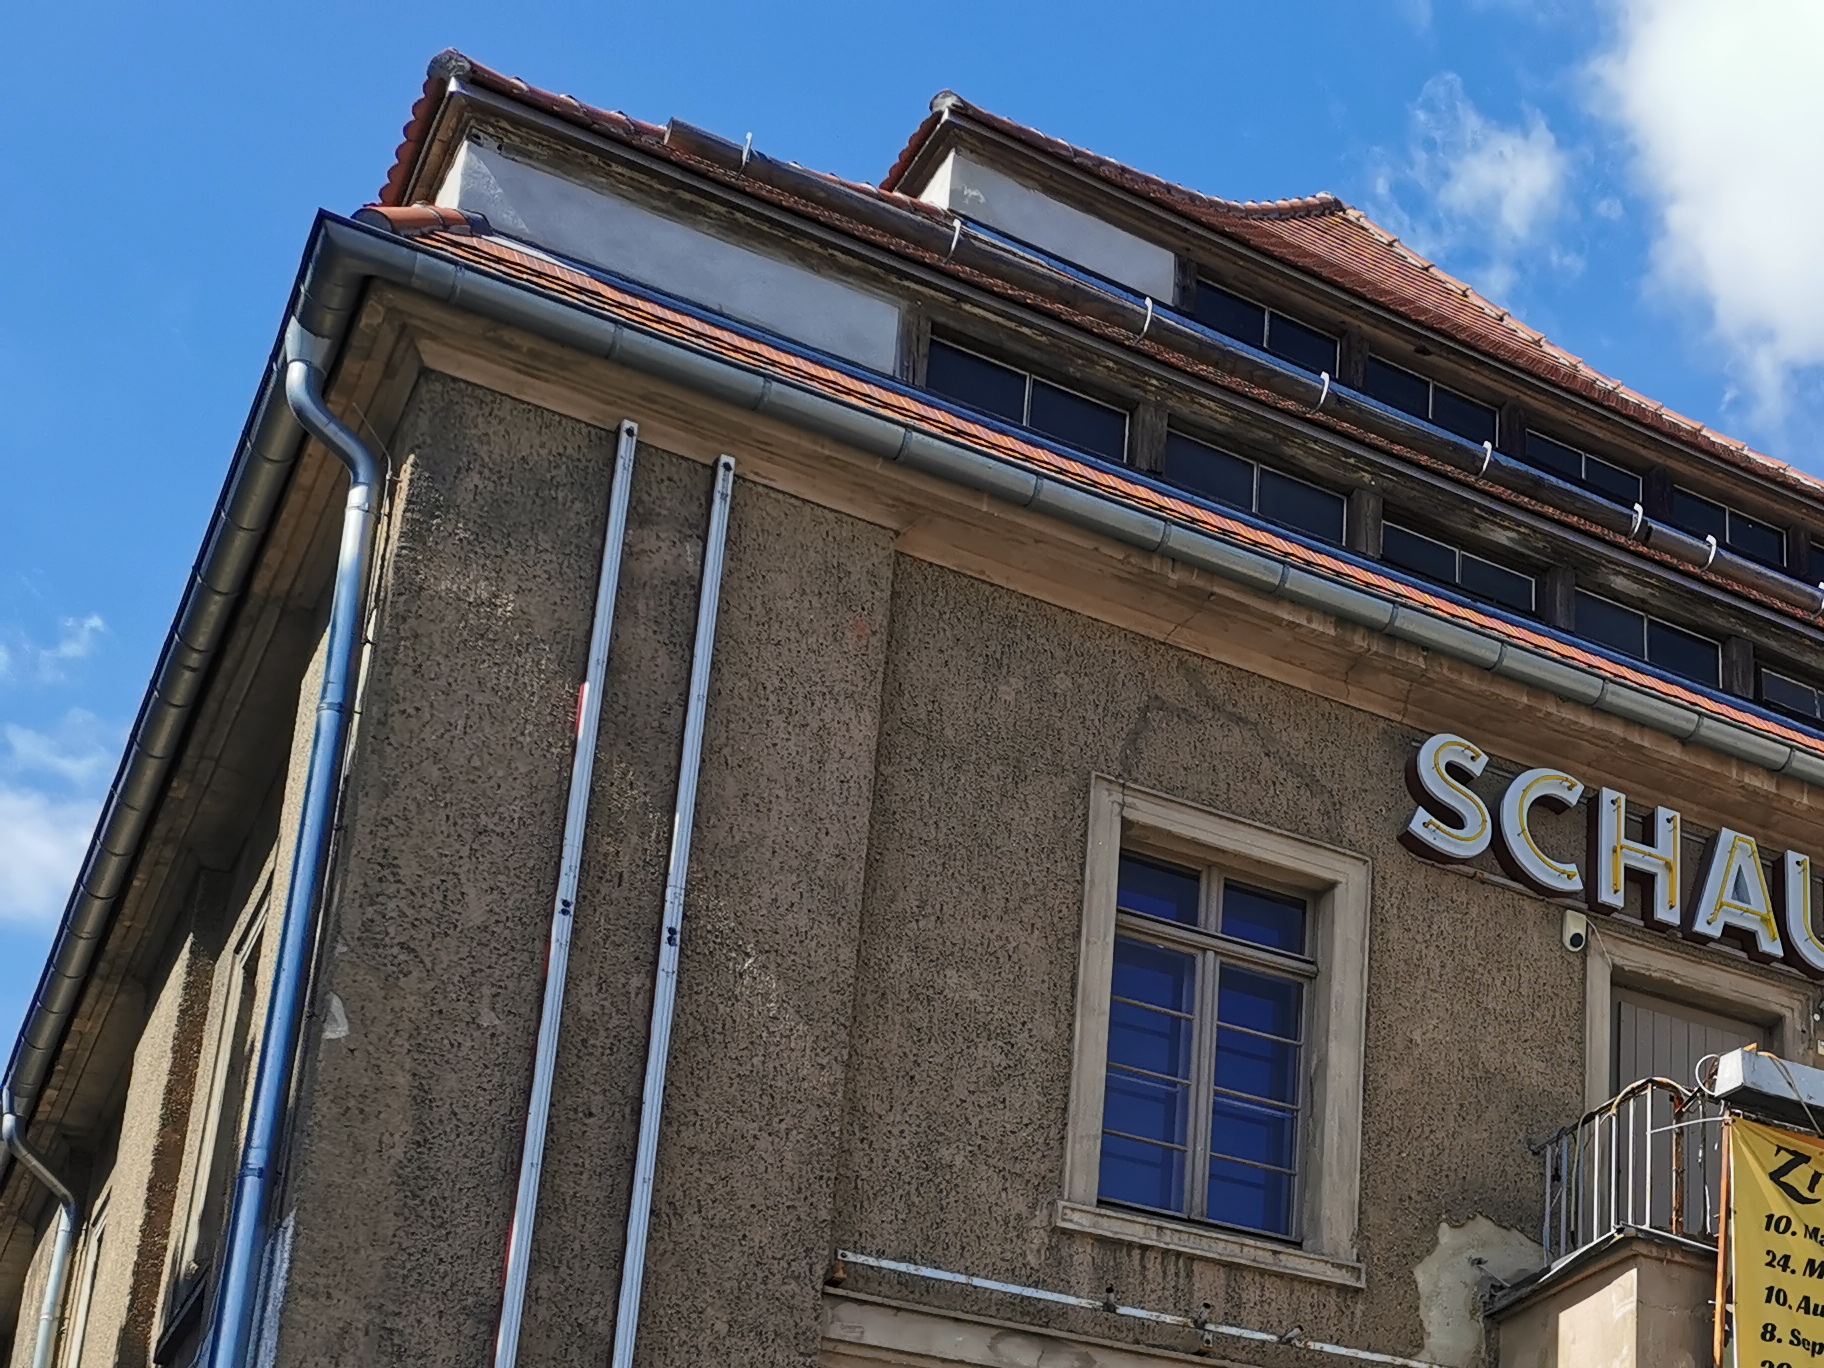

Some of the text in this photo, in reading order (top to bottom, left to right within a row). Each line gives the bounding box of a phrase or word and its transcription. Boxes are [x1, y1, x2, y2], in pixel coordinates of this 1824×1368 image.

[1764, 1213, 1798, 1237] 10.
[1764, 1249, 1797, 1275] 24.
[1764, 1285, 1793, 1311] 10.
[1759, 1322, 1783, 1343] 8.
